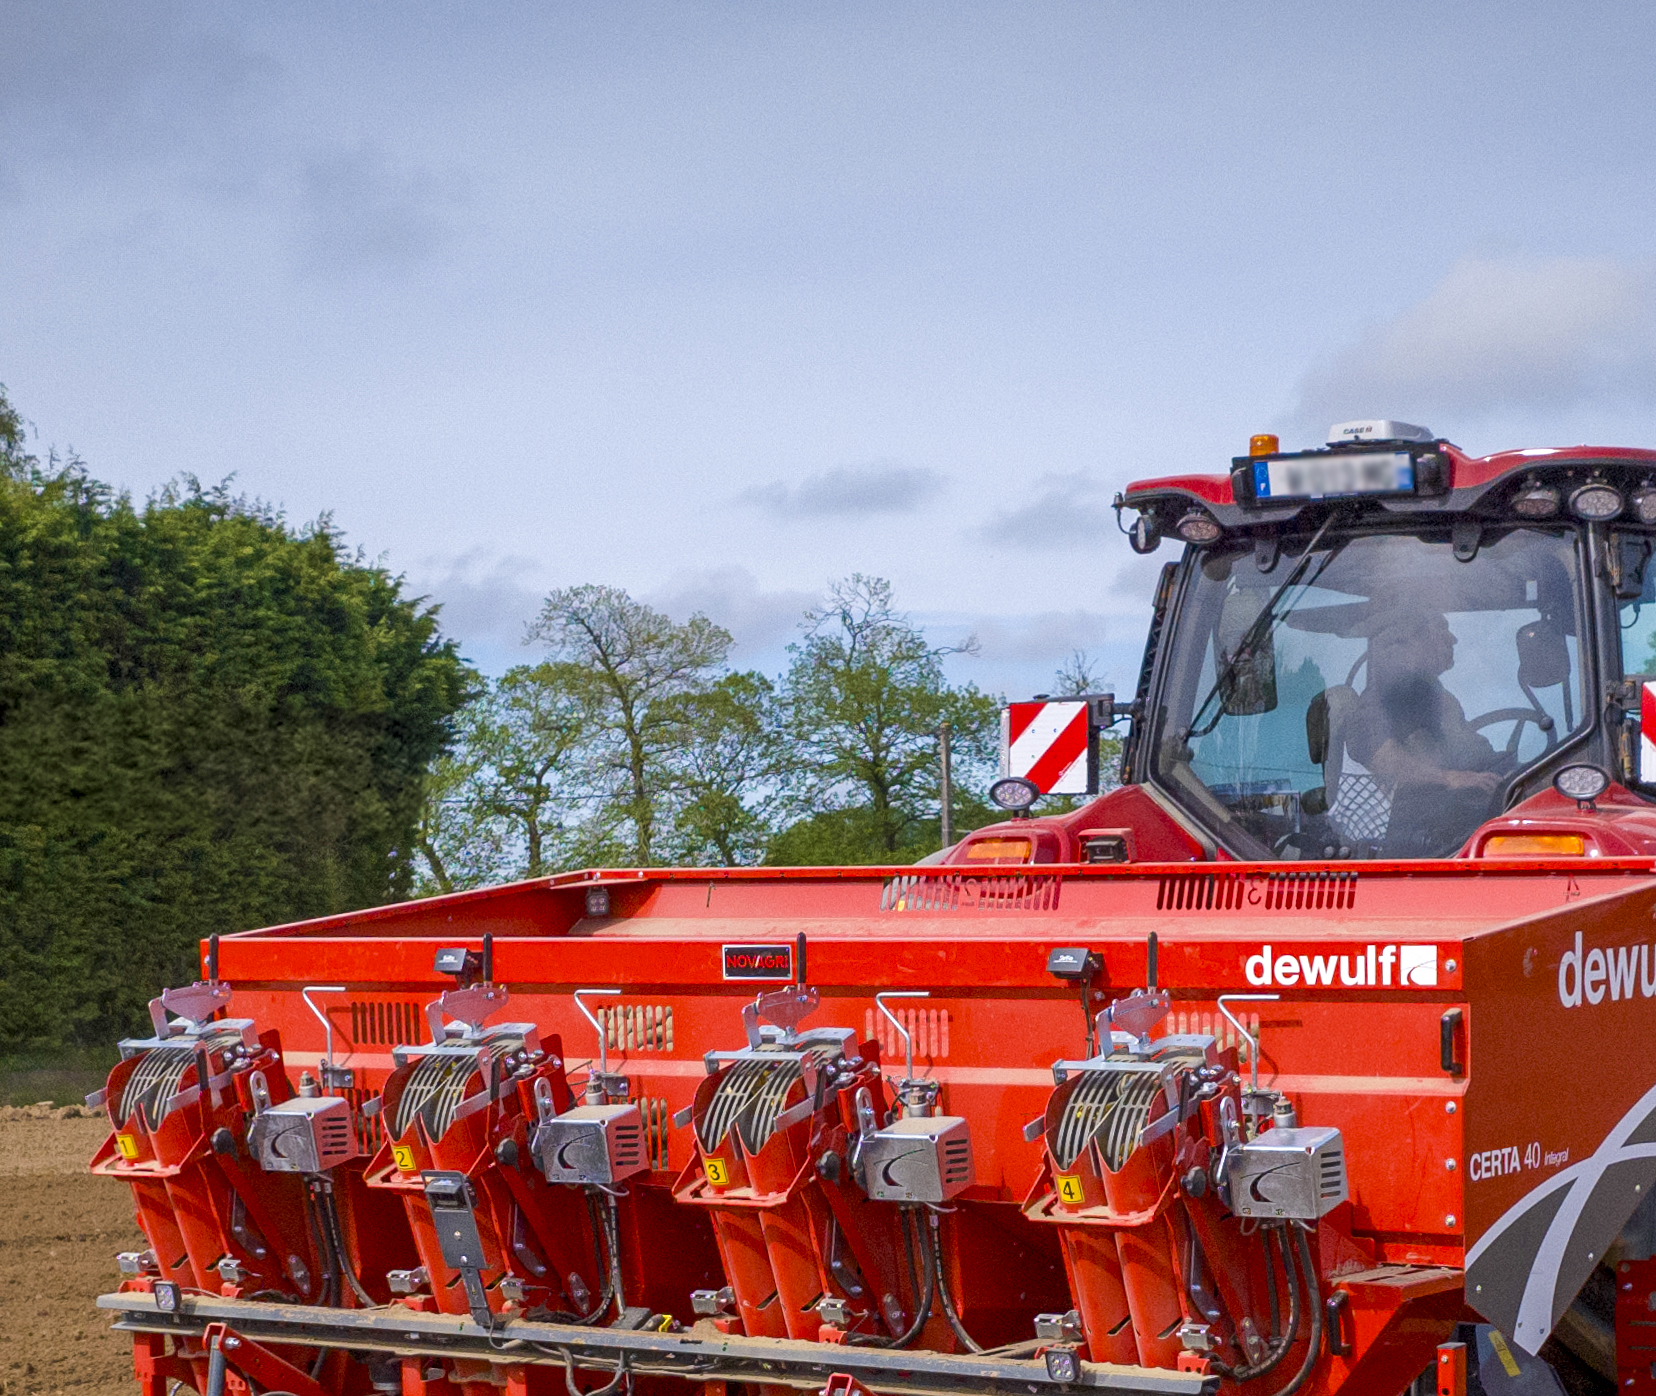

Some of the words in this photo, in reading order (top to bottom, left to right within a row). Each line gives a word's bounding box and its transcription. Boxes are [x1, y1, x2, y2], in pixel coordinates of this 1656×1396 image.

[1245, 945, 1396, 985] dewulf
[120, 1140, 129, 1155] 1
[396, 1150, 408, 1167] 2
[1470, 1146, 1521, 1181] CERTA
[1524, 1141, 1541, 1169] 40
[708, 1163, 720, 1180] 3
[1063, 1181, 1074, 1199] 4
